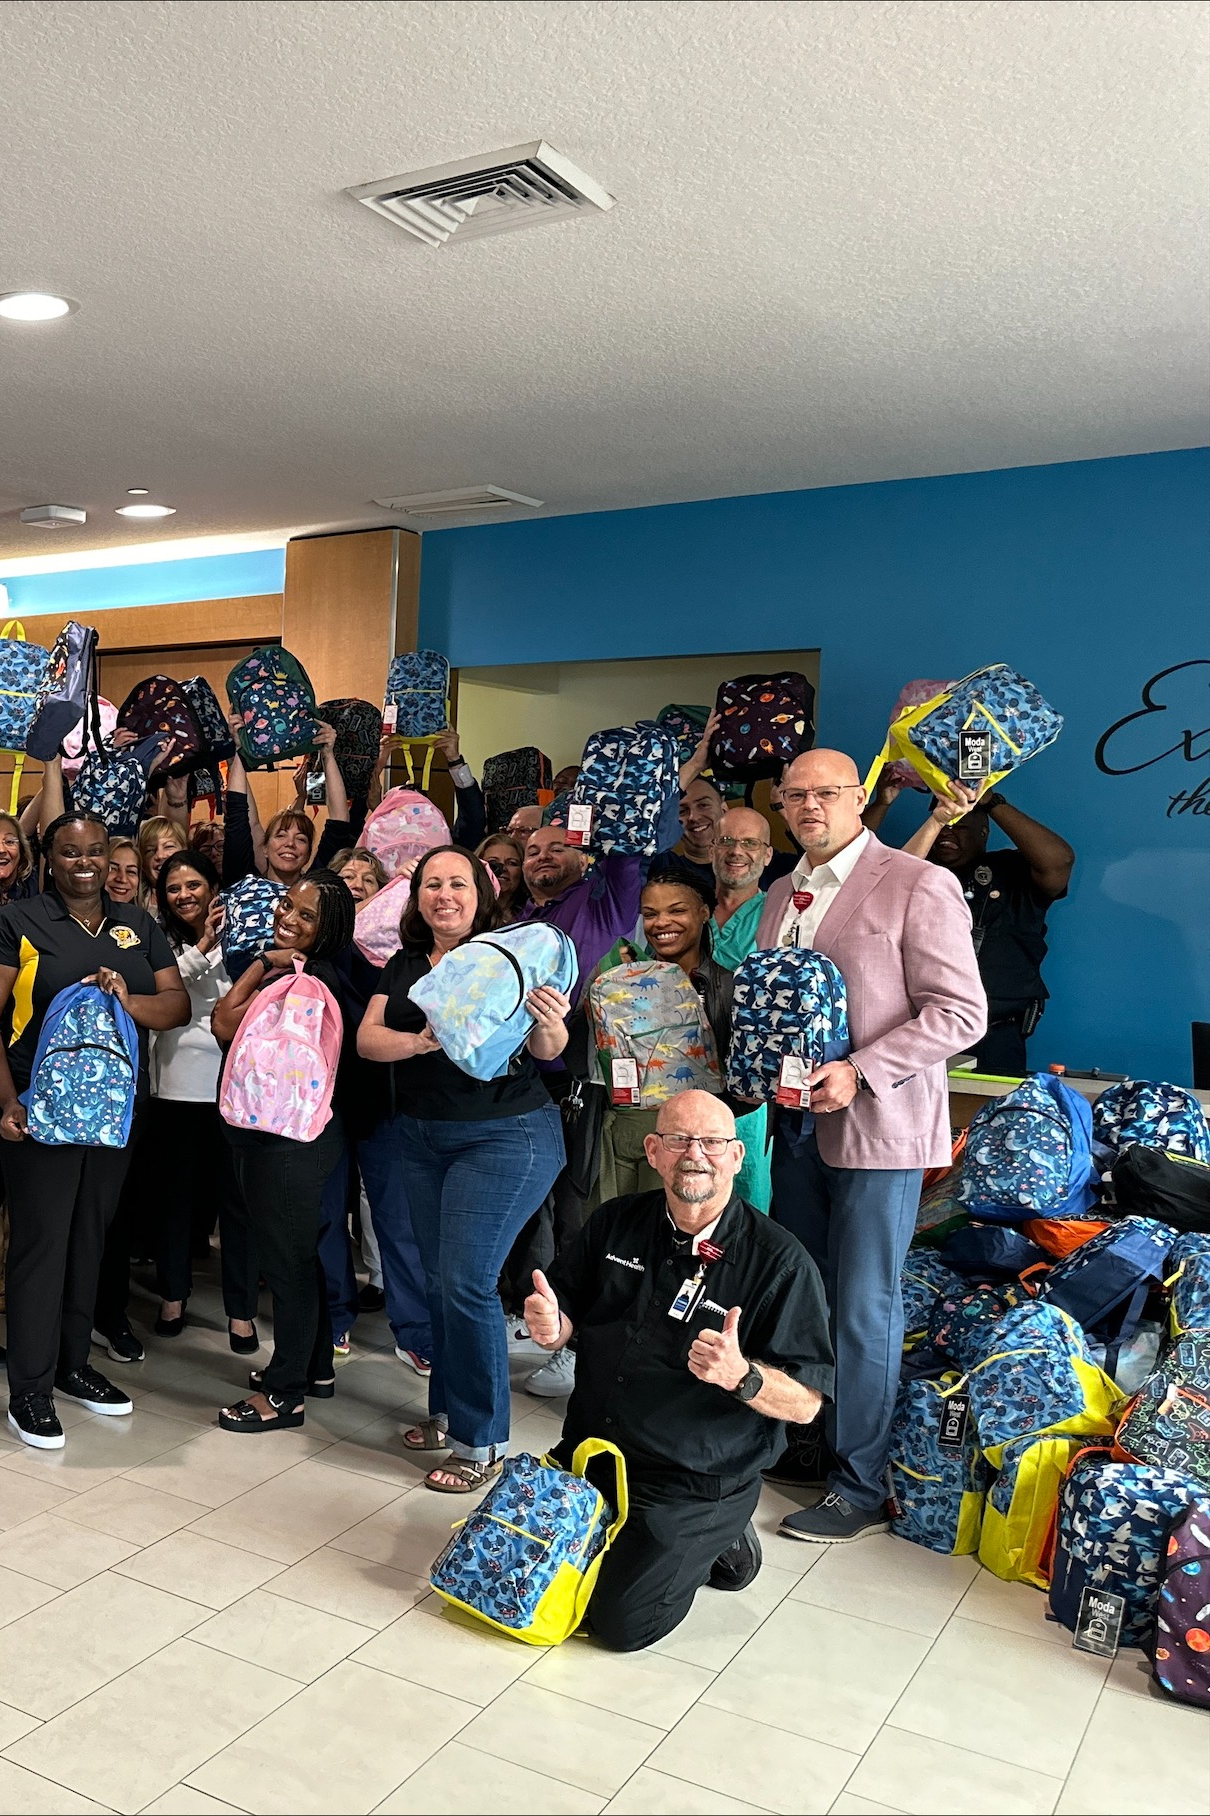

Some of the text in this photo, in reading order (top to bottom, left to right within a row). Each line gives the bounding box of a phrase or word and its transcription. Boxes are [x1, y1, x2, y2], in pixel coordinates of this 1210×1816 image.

[964, 737, 986, 747] Moda
[605, 1253, 645, 1272] AdventHealth
[947, 1400, 965, 1412] Moda
[1088, 1596, 1115, 1615] Moda
[1092, 1607, 1110, 1621] West
